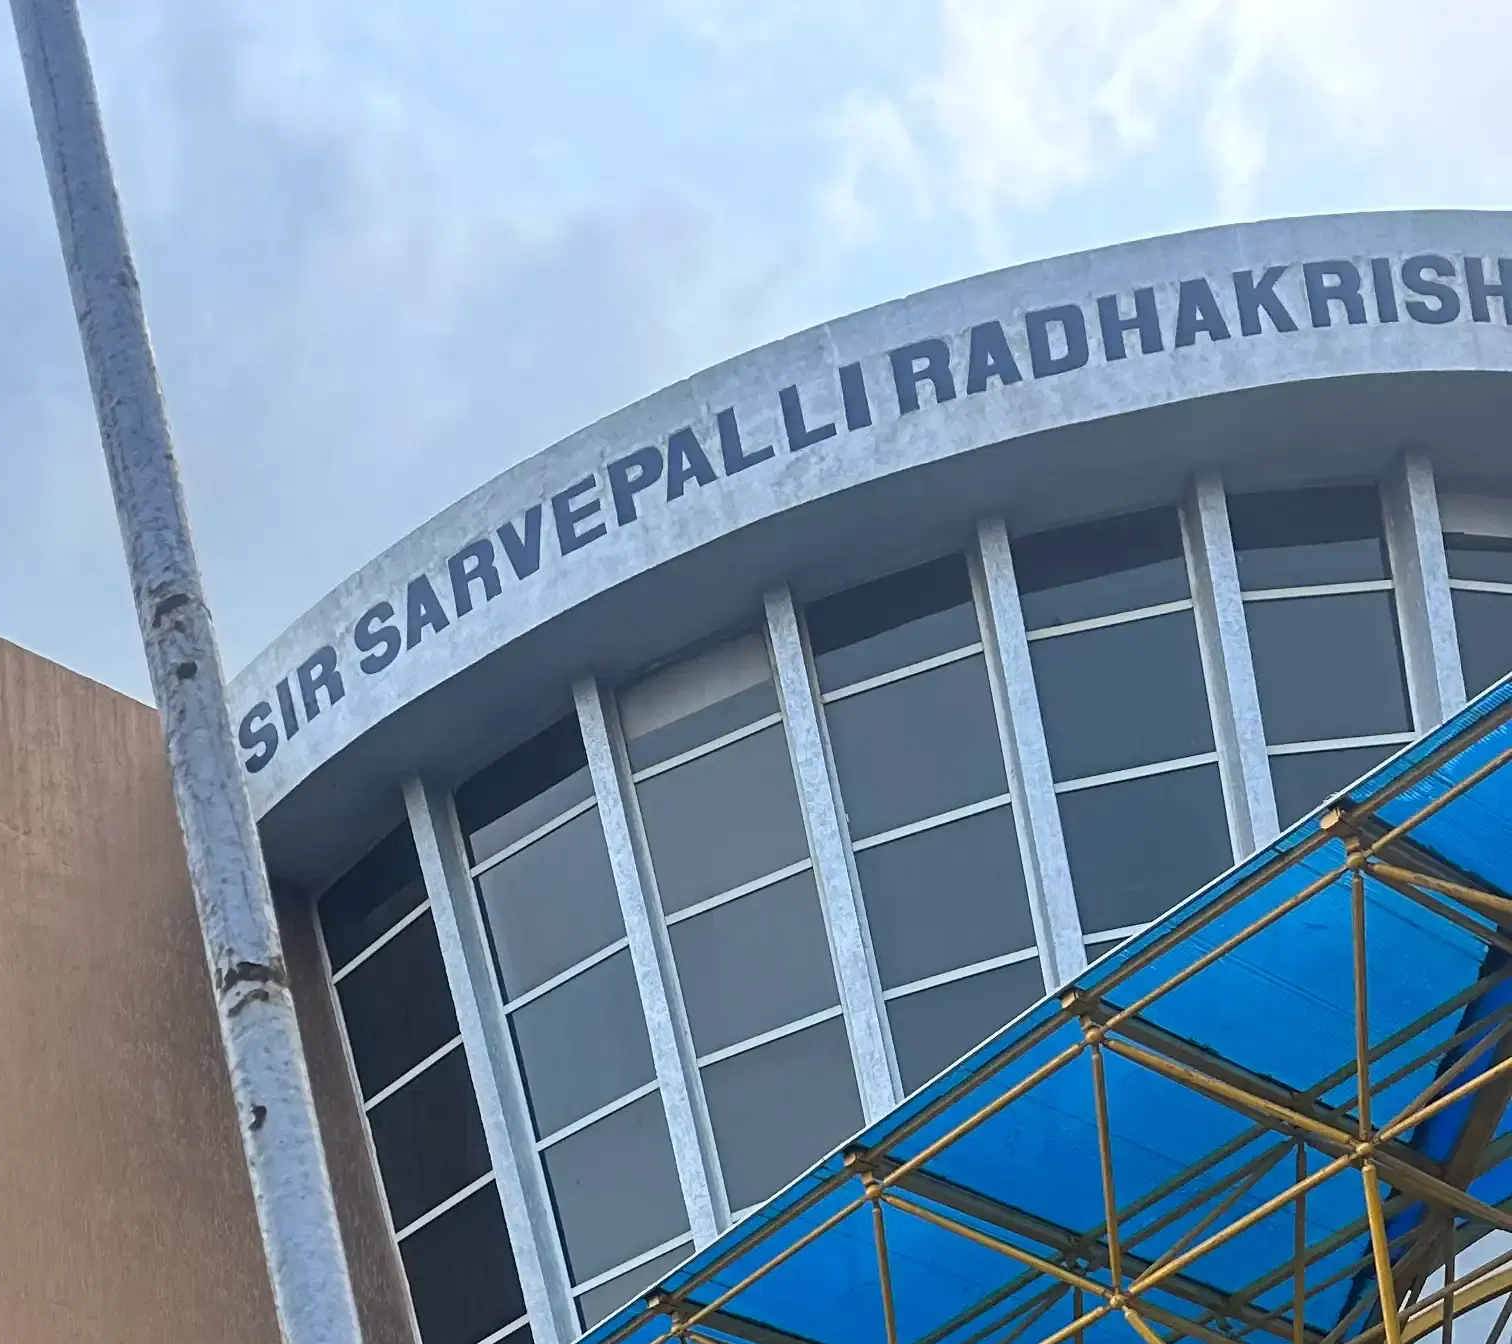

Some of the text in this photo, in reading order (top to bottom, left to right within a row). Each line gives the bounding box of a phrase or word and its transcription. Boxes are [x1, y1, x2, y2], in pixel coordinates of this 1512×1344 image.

[237, 254, 1512, 775] SIR SARVEPALLI RADHAKRISH
